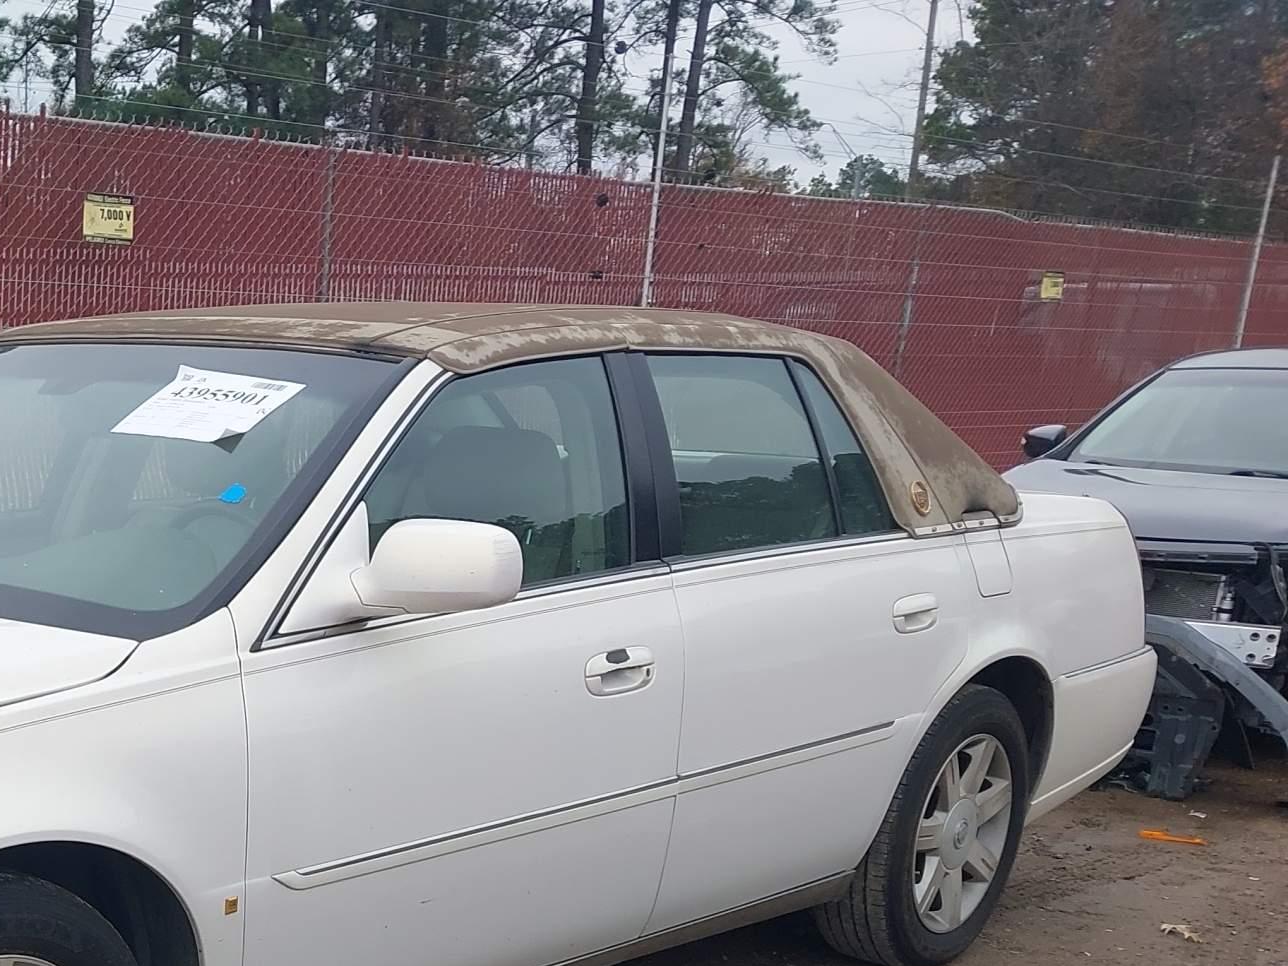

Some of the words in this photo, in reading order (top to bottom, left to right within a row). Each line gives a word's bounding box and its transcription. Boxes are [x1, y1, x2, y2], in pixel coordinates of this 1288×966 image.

[100, 208, 123, 221] 7,000
[125, 210, 132, 221] V
[170, 386, 269, 406] 43955901
